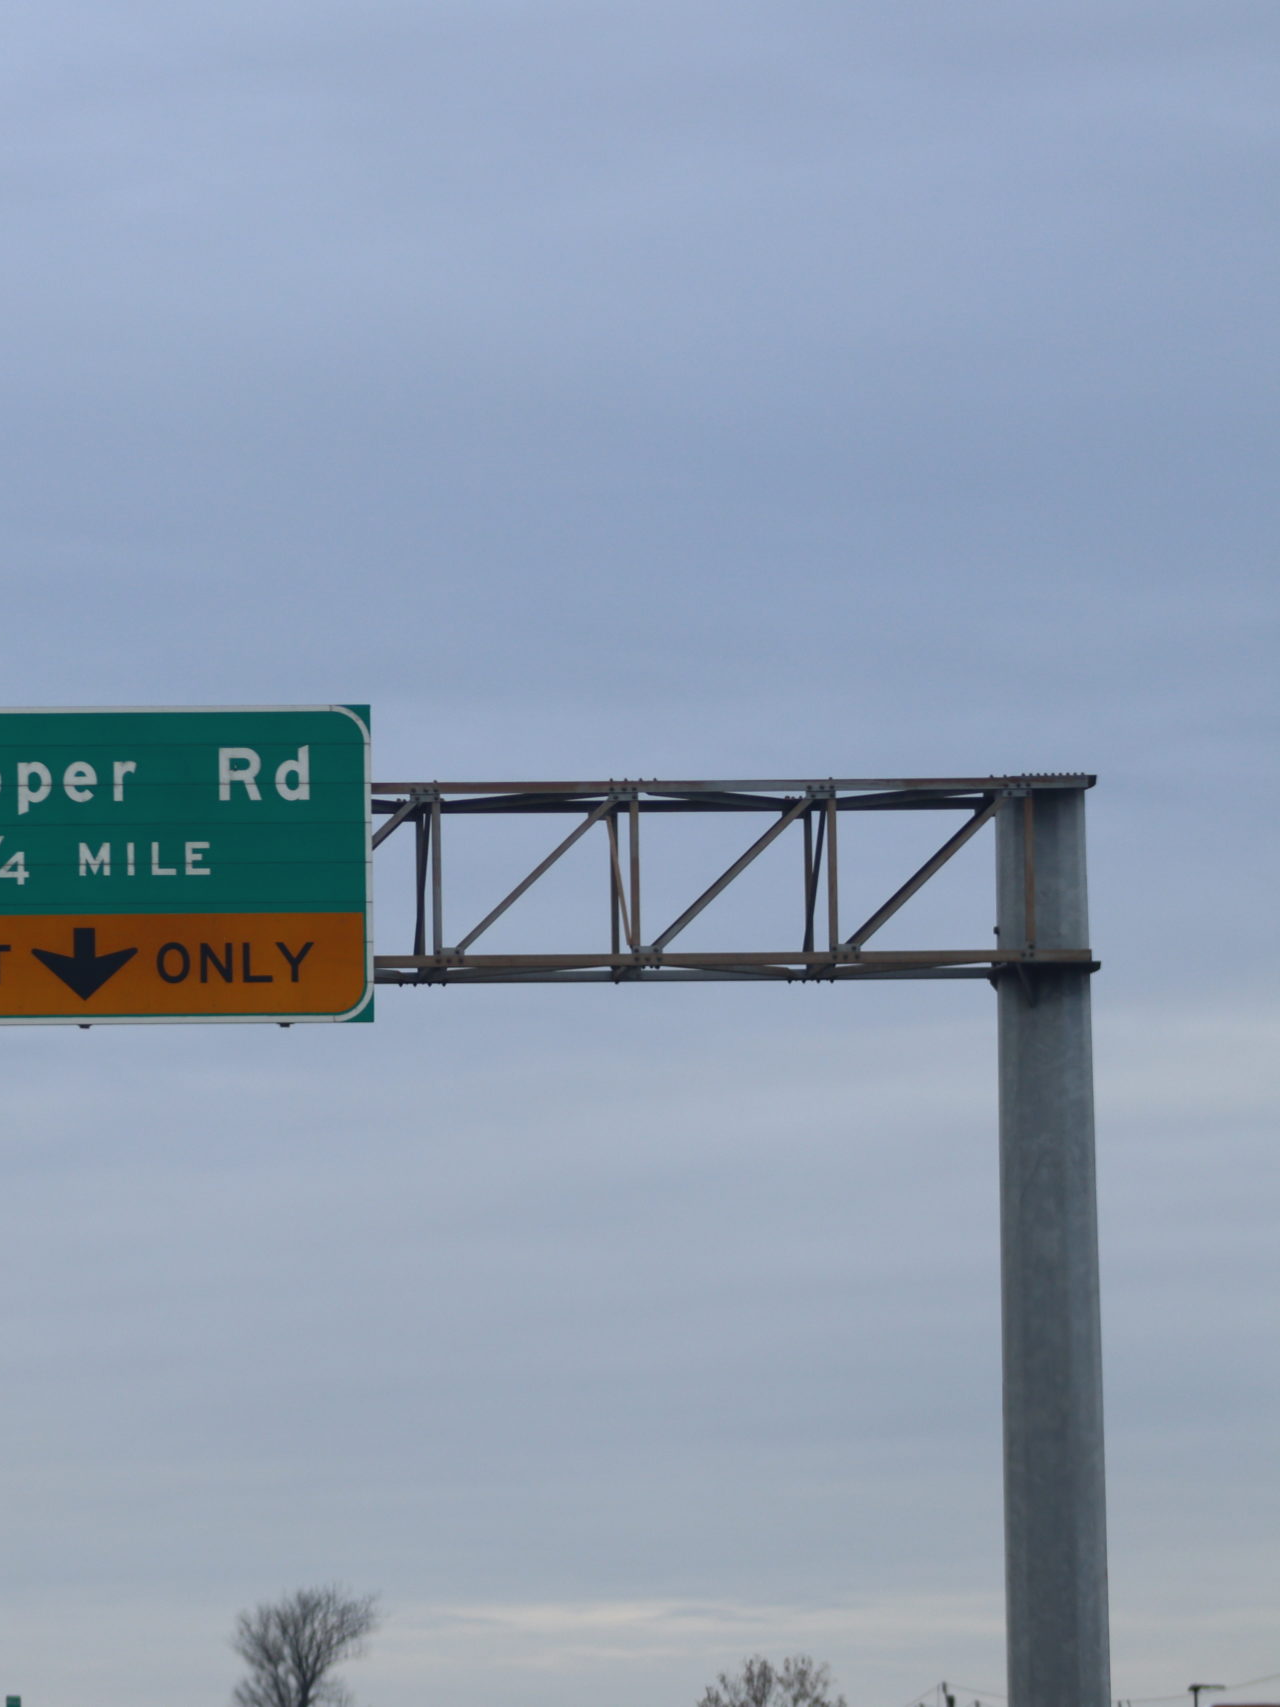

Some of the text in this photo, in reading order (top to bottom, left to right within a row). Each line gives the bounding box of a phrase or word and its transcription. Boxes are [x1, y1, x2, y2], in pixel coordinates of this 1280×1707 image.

[218, 745, 311, 802] Rd
[78, 841, 212, 876] MILE
[154, 940, 316, 985] ONLY
